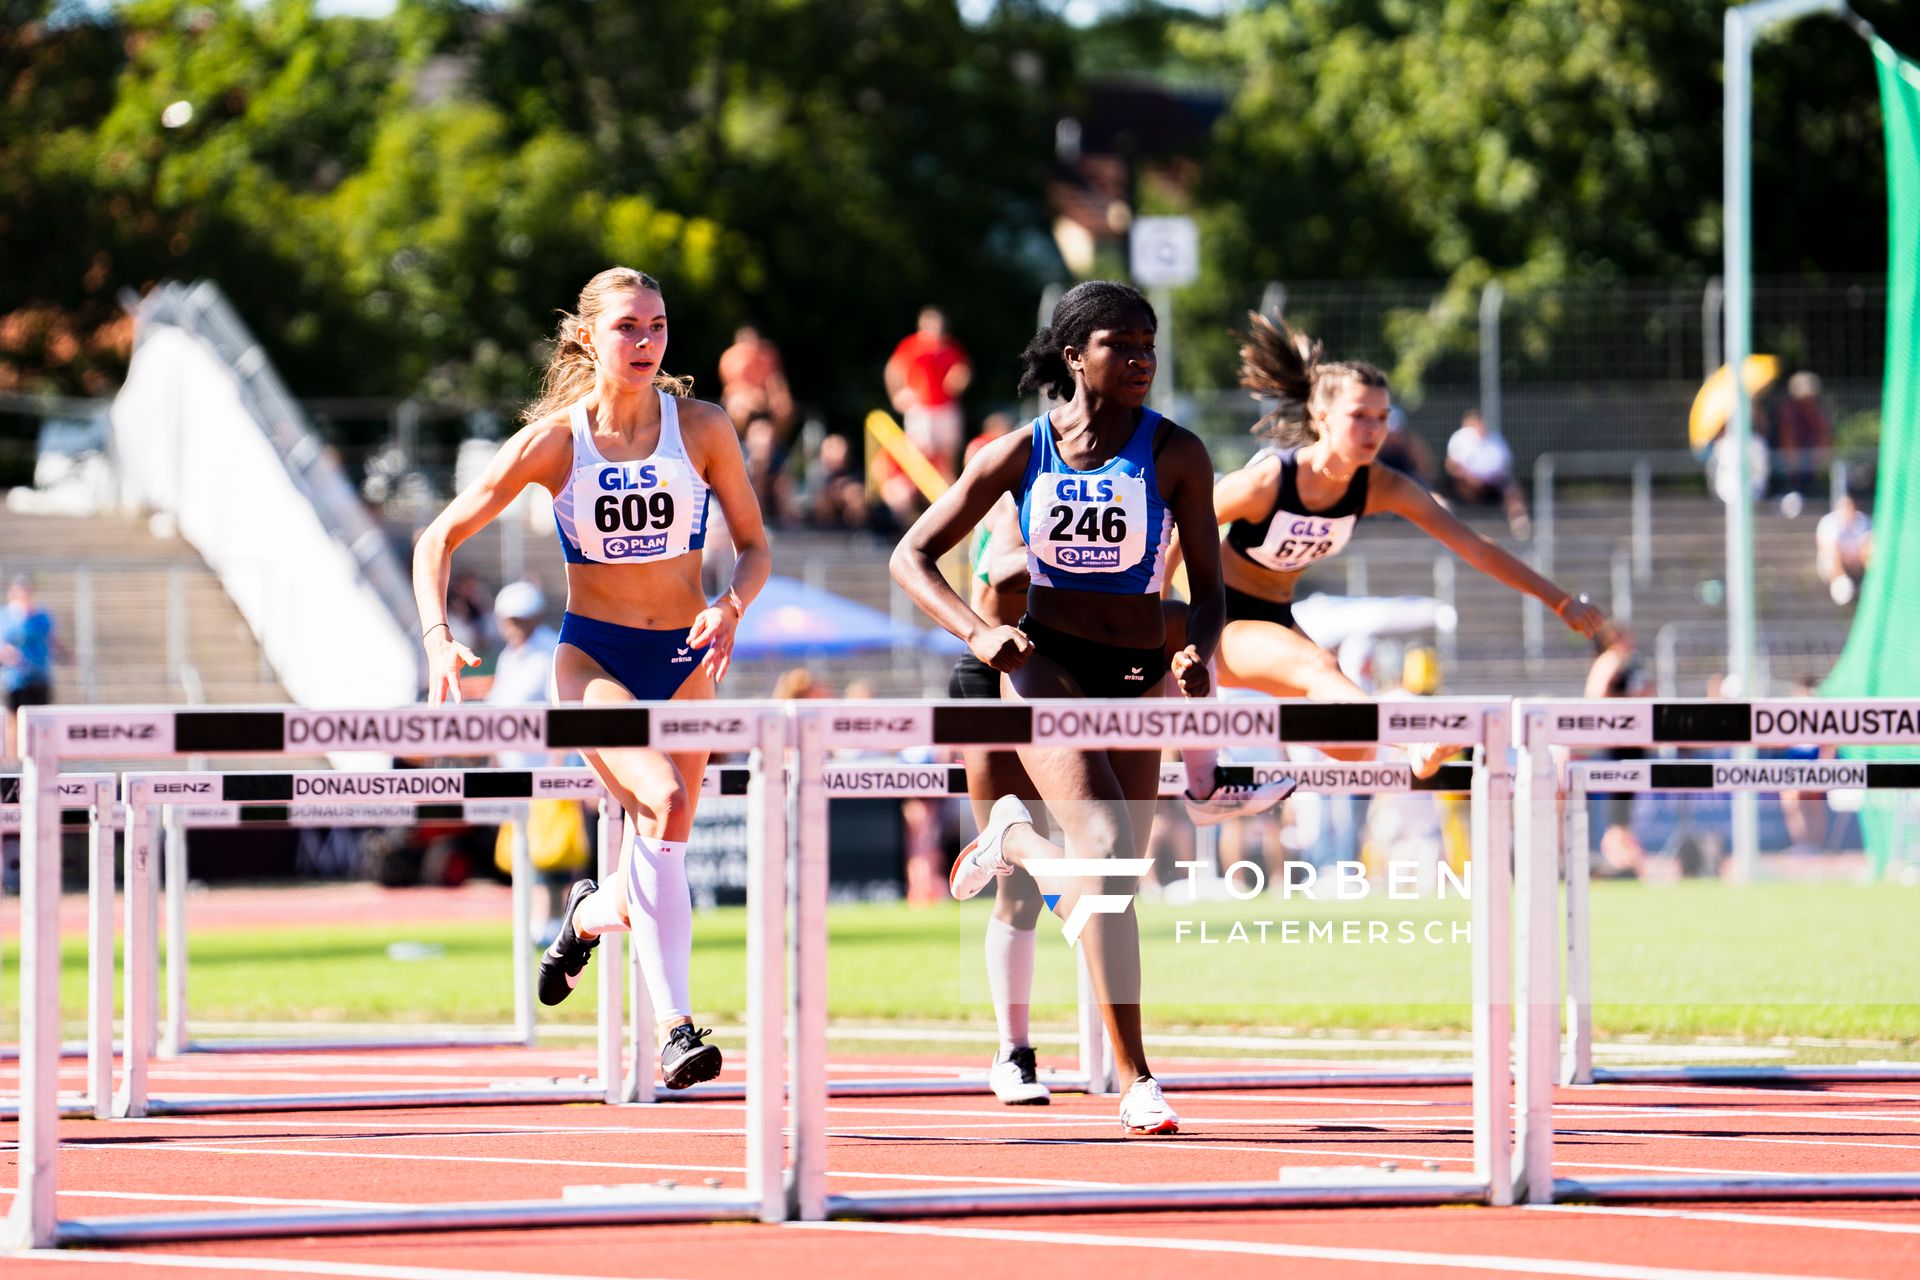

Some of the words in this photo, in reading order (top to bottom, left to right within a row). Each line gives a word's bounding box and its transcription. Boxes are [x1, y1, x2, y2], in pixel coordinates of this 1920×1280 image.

[595, 492, 674, 532] 609
[1049, 505, 1127, 542] 246
[630, 537, 666, 549] PLAN
[1081, 550, 1118, 560] PLAN
[67, 724, 156, 739] BENZ
[288, 715, 541, 744] DONAUSTADION
[660, 718, 745, 735] BENZ
[832, 716, 915, 732] BENZ
[1036, 710, 1275, 738] DONAUSTADION
[1388, 714, 1468, 730] BENZ
[1557, 714, 1637, 730] BENZ
[1755, 709, 1920, 735] DONAUSTA
[153, 782, 211, 793] BENZ
[295, 776, 461, 796] DONAUSTADION
[539, 777, 593, 789] BENZ
[822, 771, 945, 790] NAUSTADION
[1589, 769, 1640, 781] BENZ
[1715, 766, 1865, 786] DONAUSTADION
